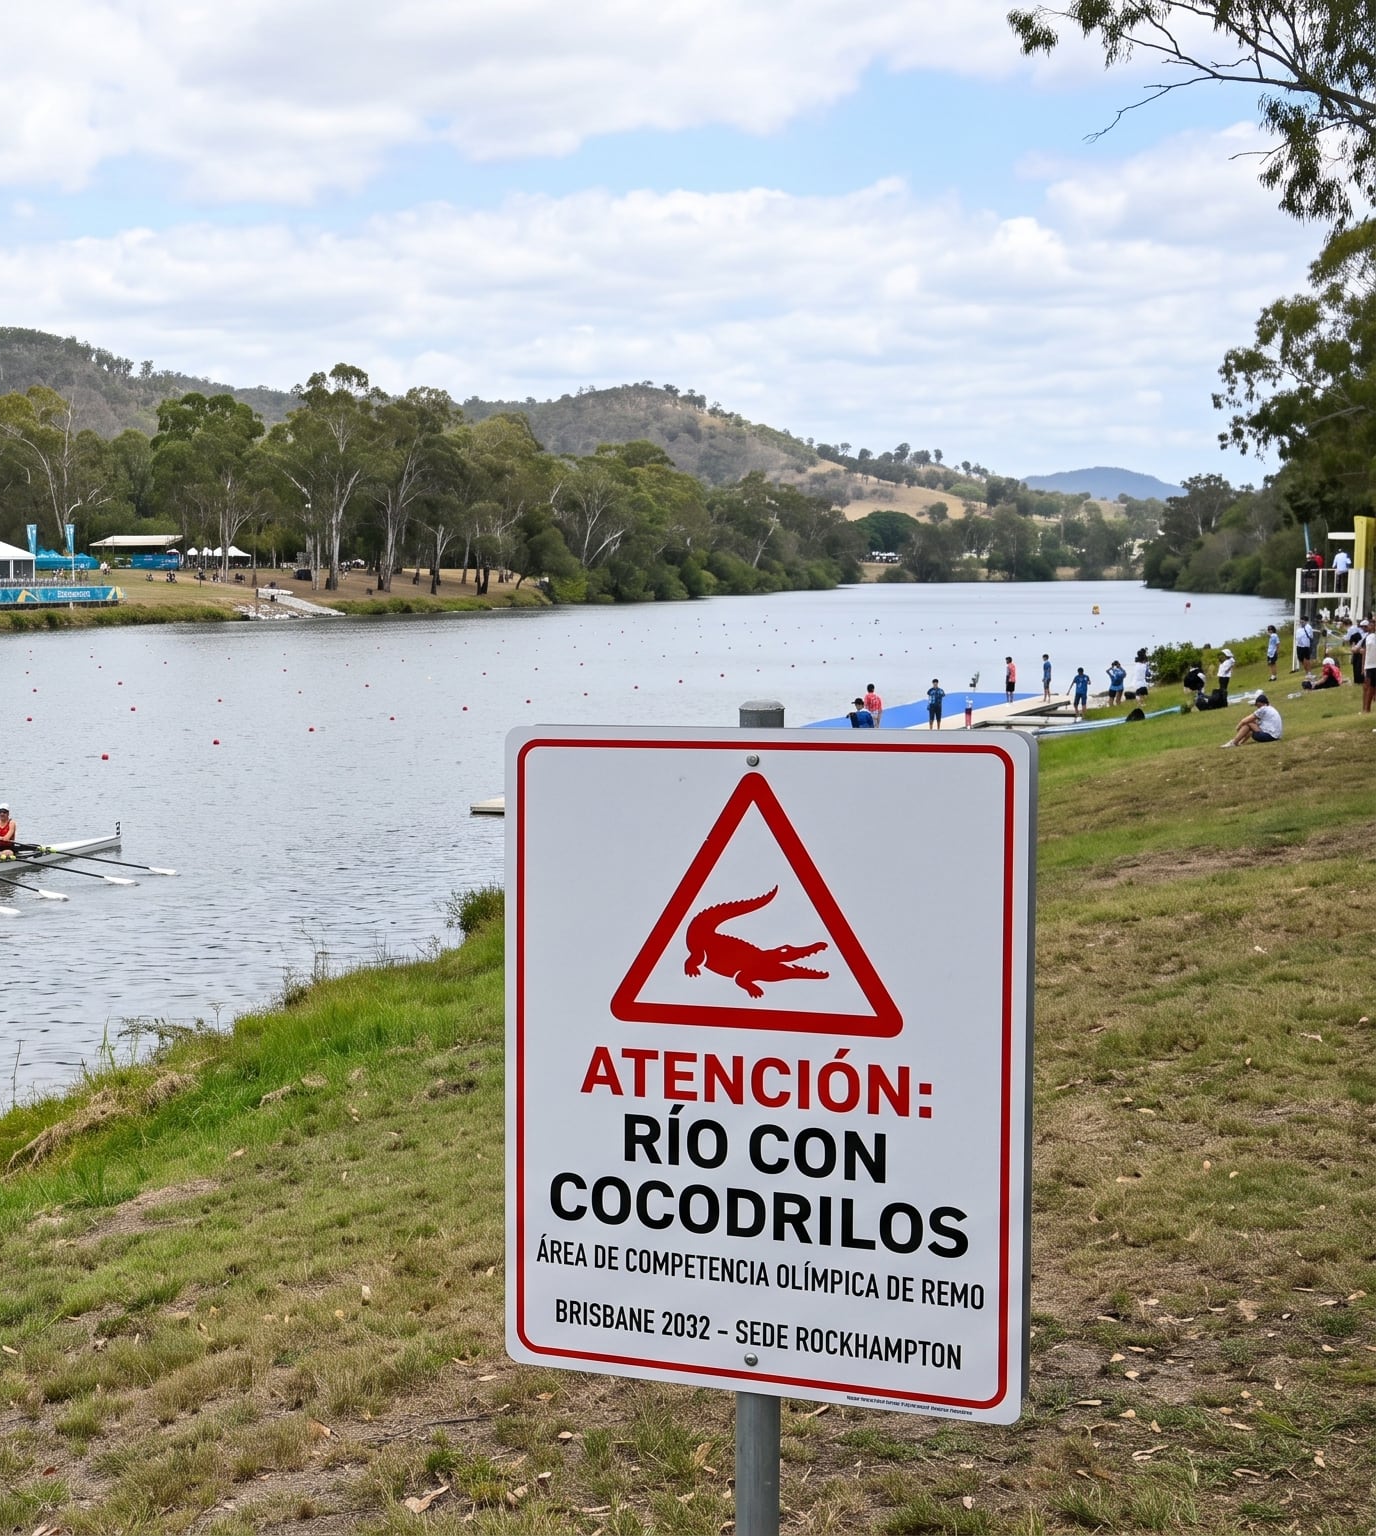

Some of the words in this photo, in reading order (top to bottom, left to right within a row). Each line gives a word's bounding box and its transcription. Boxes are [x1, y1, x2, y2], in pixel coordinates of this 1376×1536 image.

[581, 1046, 933, 1119] ATENCIÓN:
[624, 1104, 728, 1170] RÍO
[749, 1123, 887, 1184] CON
[550, 1172, 969, 1259] COCODRILOS
[536, 1233, 588, 1268] ÁREA
[594, 1244, 619, 1271] DE
[625, 1247, 770, 1287] COMPETENCIA
[776, 1260, 880, 1299] OLÍMPICA
[886, 1275, 914, 1303] DE
[921, 1279, 985, 1310] REMO
[555, 1298, 655, 1334] BRISBANE
[661, 1311, 711, 1341] 2032
[735, 1319, 789, 1350] SEDE
[796, 1326, 962, 1371] ROCKHAMPTON
